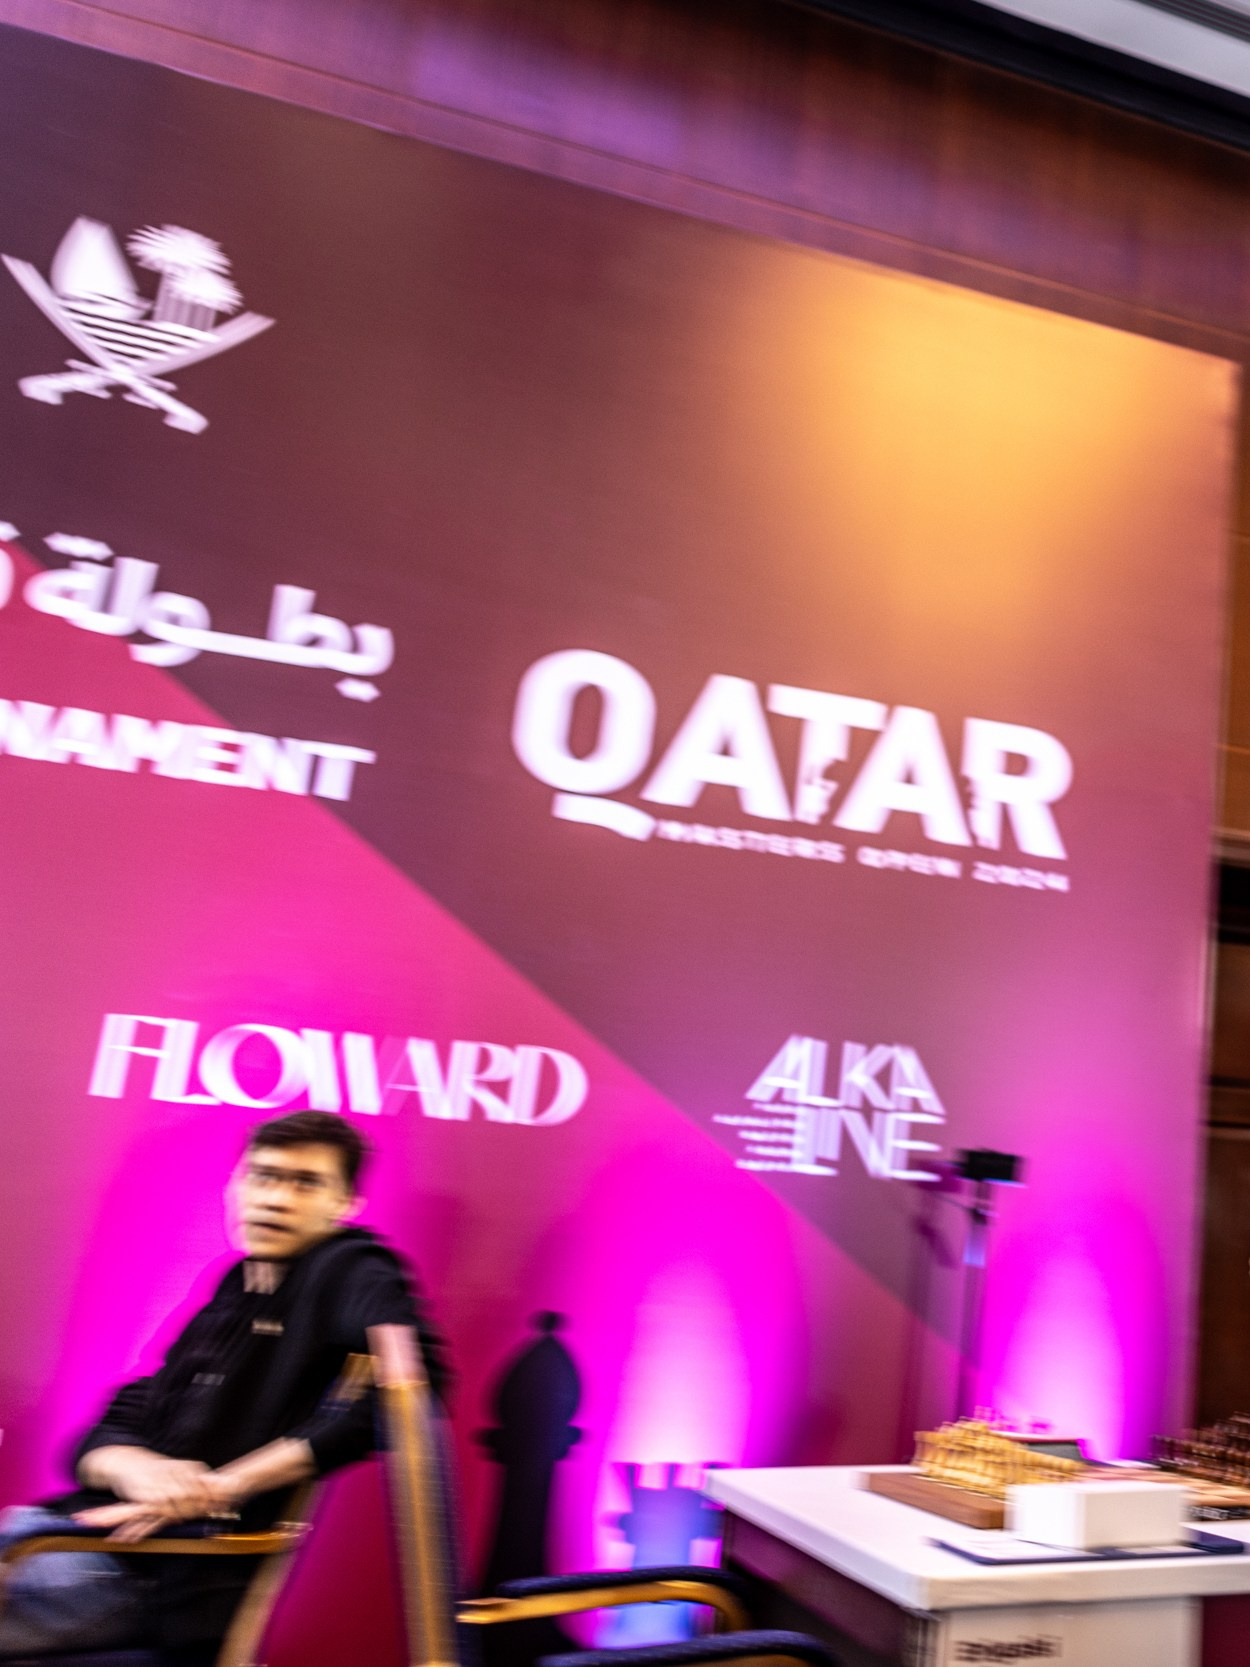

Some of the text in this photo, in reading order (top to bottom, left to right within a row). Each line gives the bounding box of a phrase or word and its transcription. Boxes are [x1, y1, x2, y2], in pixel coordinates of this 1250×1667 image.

[23, 532, 395, 701] بطولة
[511, 648, 1073, 860] QATAR
[87, 1012, 590, 1127] FLOWARD
[744, 1034, 946, 1116] ALKA
